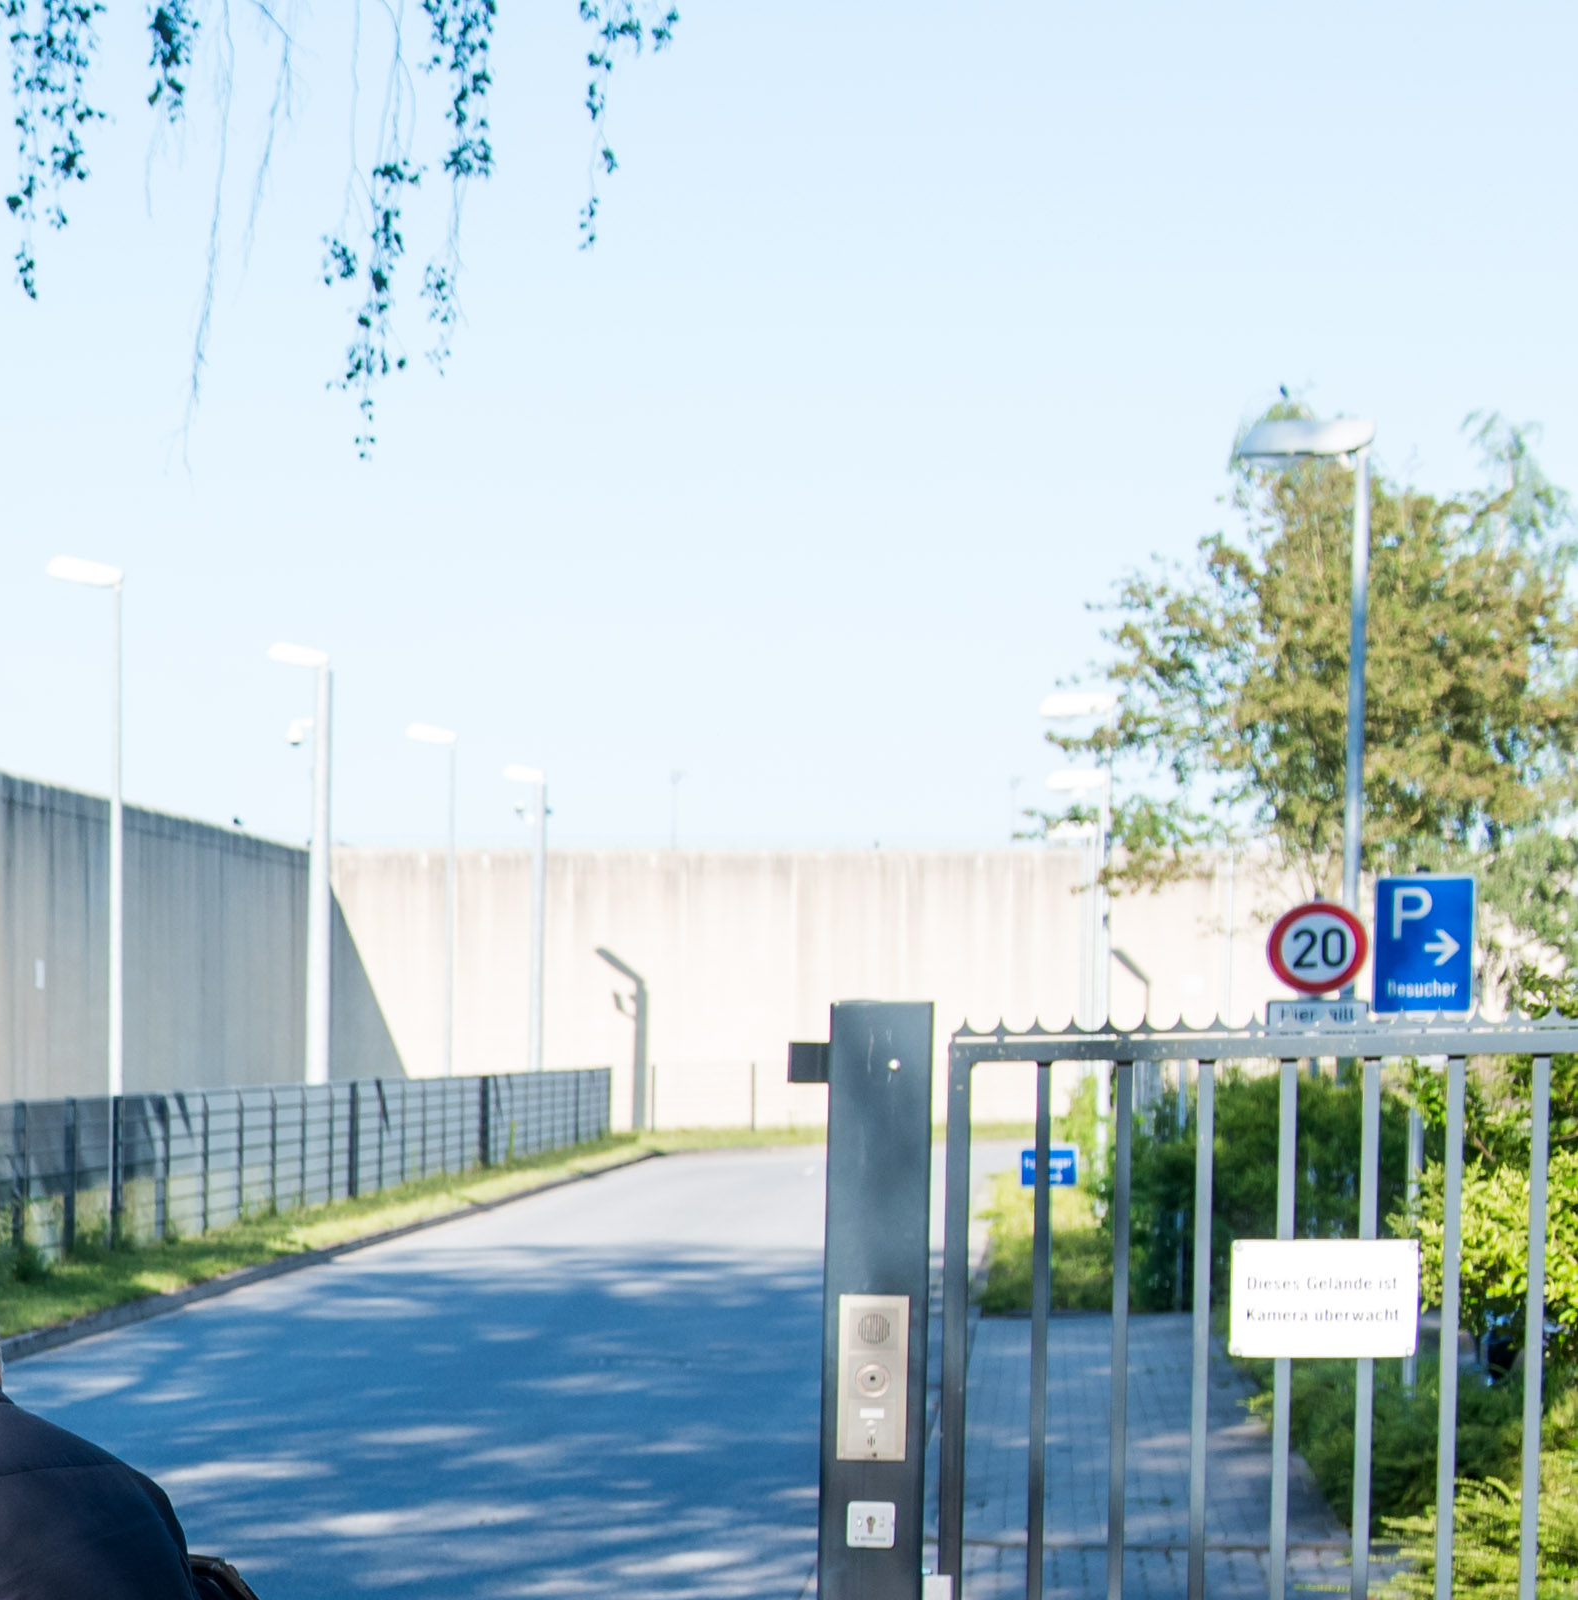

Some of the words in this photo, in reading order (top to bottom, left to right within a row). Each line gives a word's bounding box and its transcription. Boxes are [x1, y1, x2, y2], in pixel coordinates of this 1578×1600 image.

[1392, 886, 1433, 940] P
[1293, 927, 1347, 969] 20
[1386, 978, 1458, 998] Besucher
[1246, 1276, 1300, 1291] Dieses
[1378, 1276, 1398, 1291] ist
[1246, 1308, 1308, 1322] Kamera
